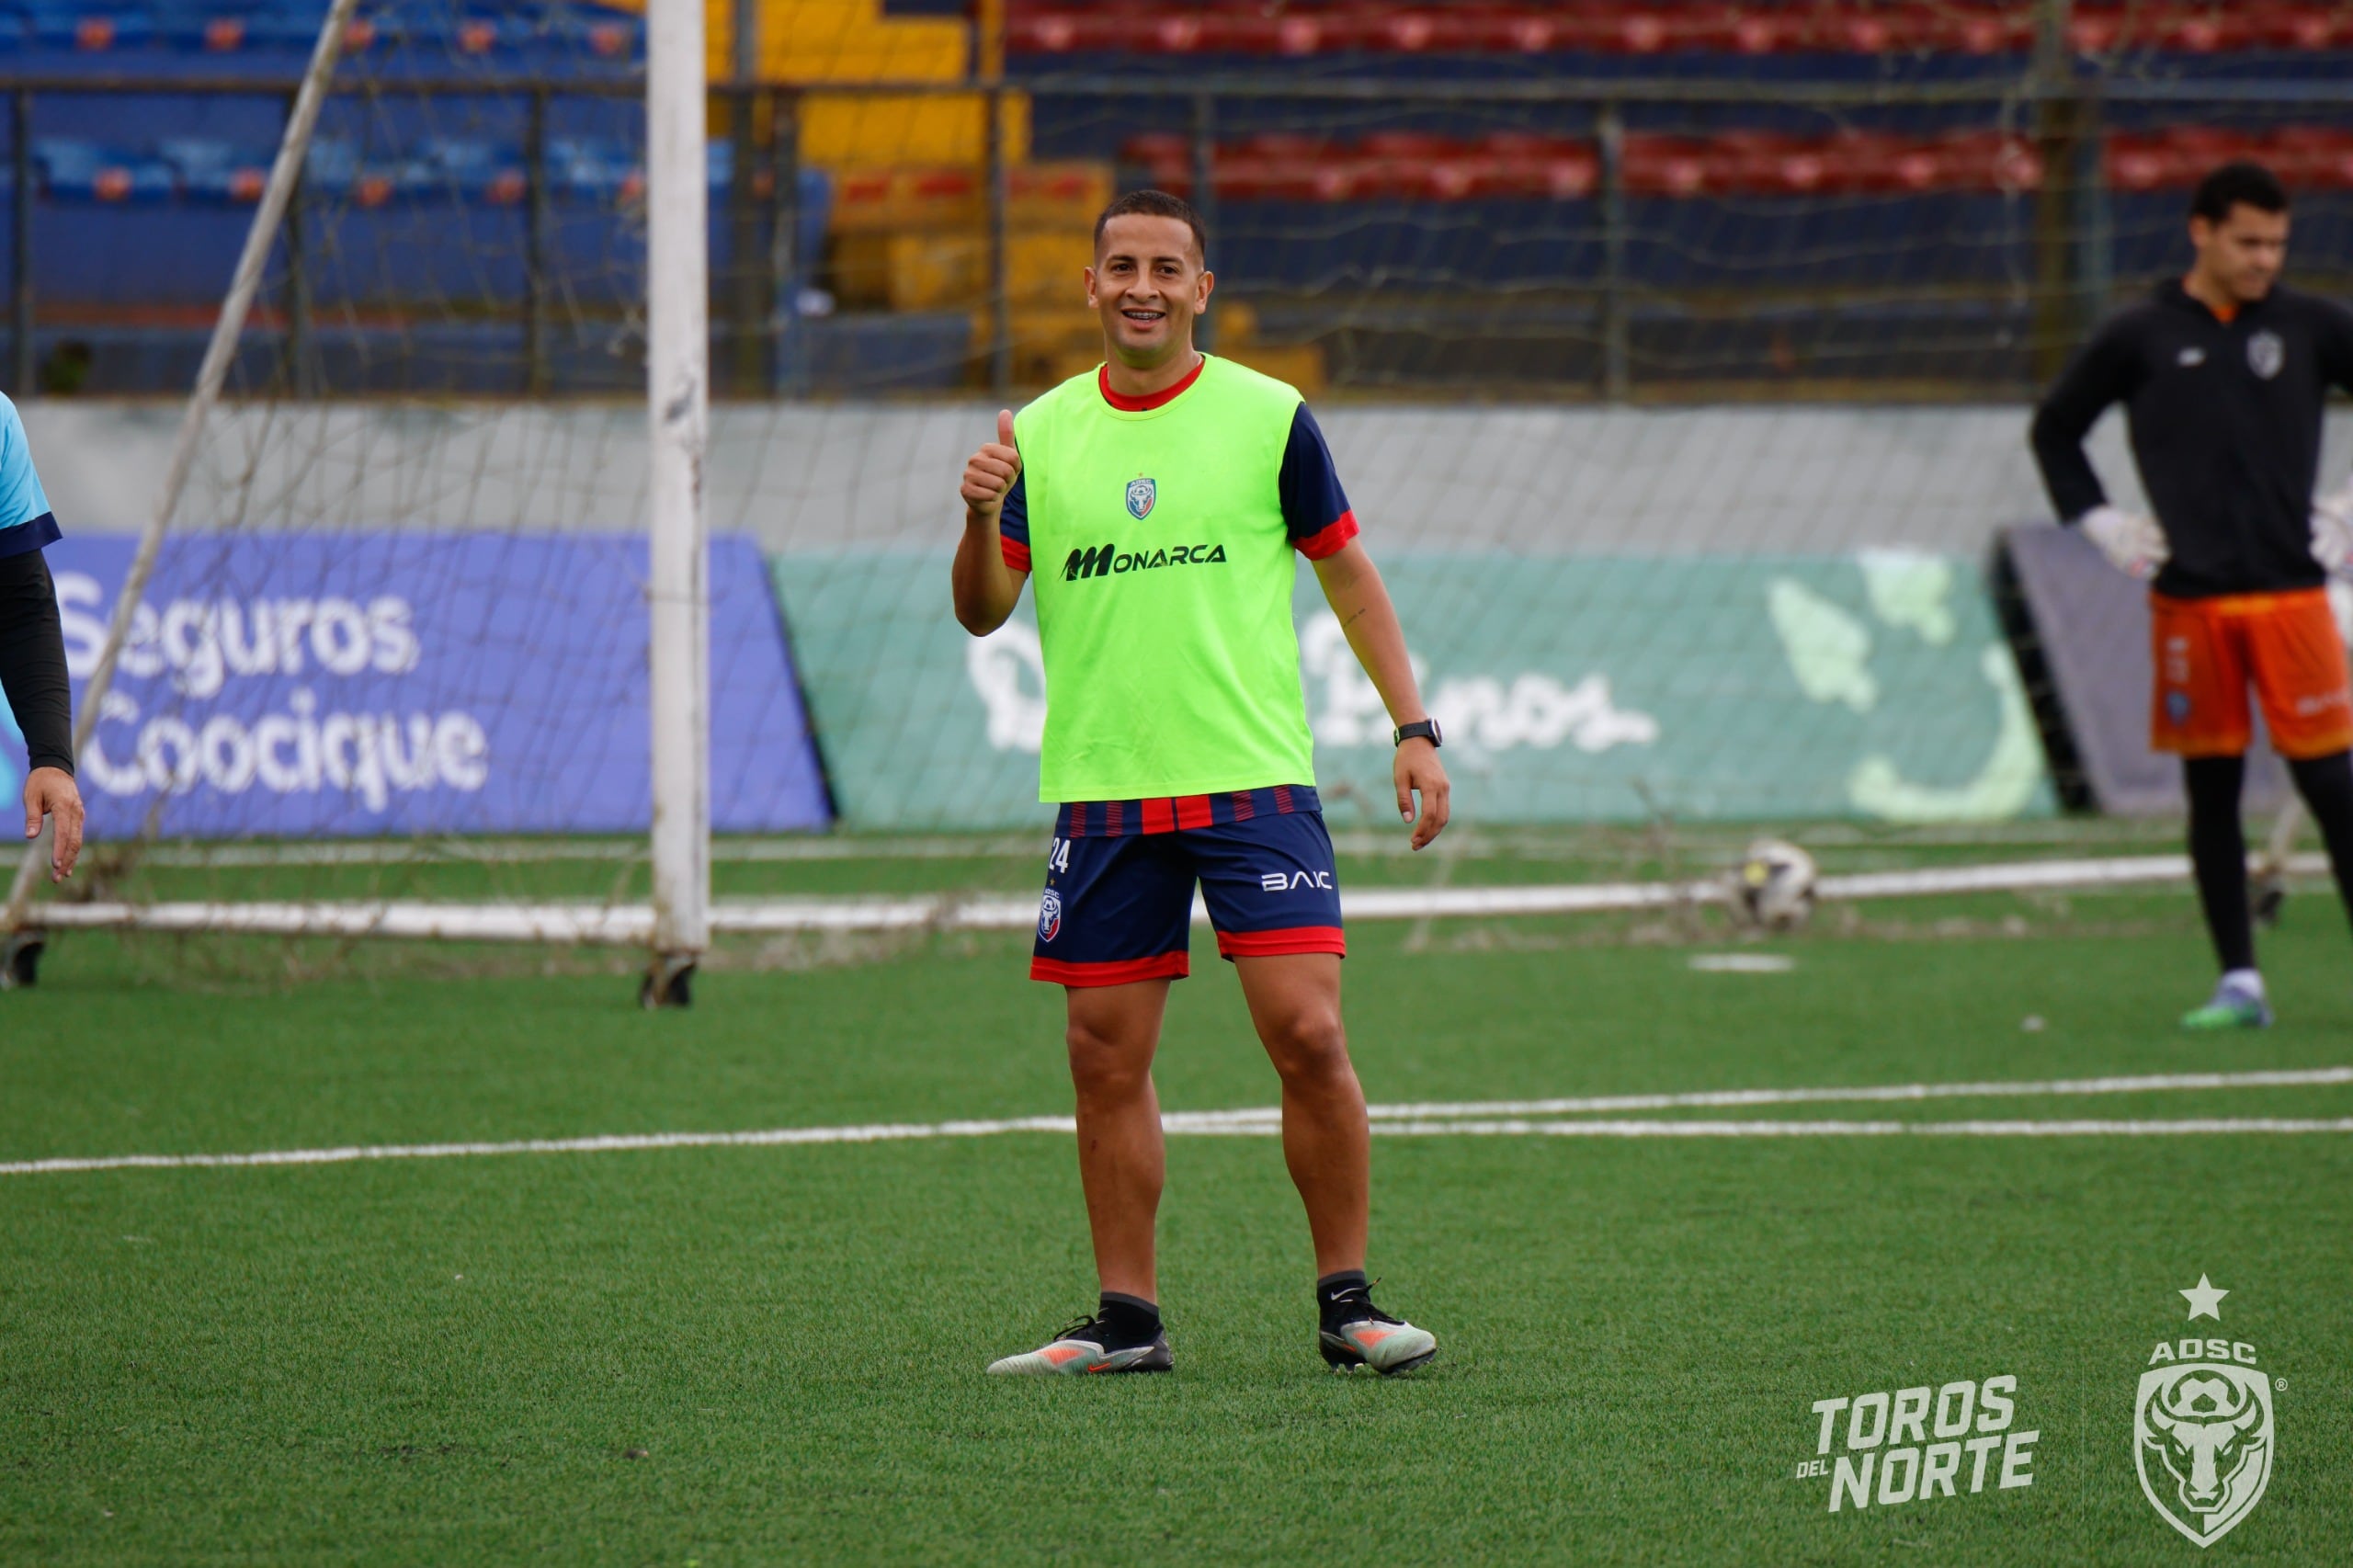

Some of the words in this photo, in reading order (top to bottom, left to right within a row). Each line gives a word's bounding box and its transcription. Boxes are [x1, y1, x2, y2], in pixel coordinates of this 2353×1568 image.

[55, 570, 421, 699] Seguros
[79, 686, 490, 813] Coocique
[1049, 837, 1071, 873] 24
[1261, 870, 1333, 892] BAIC
